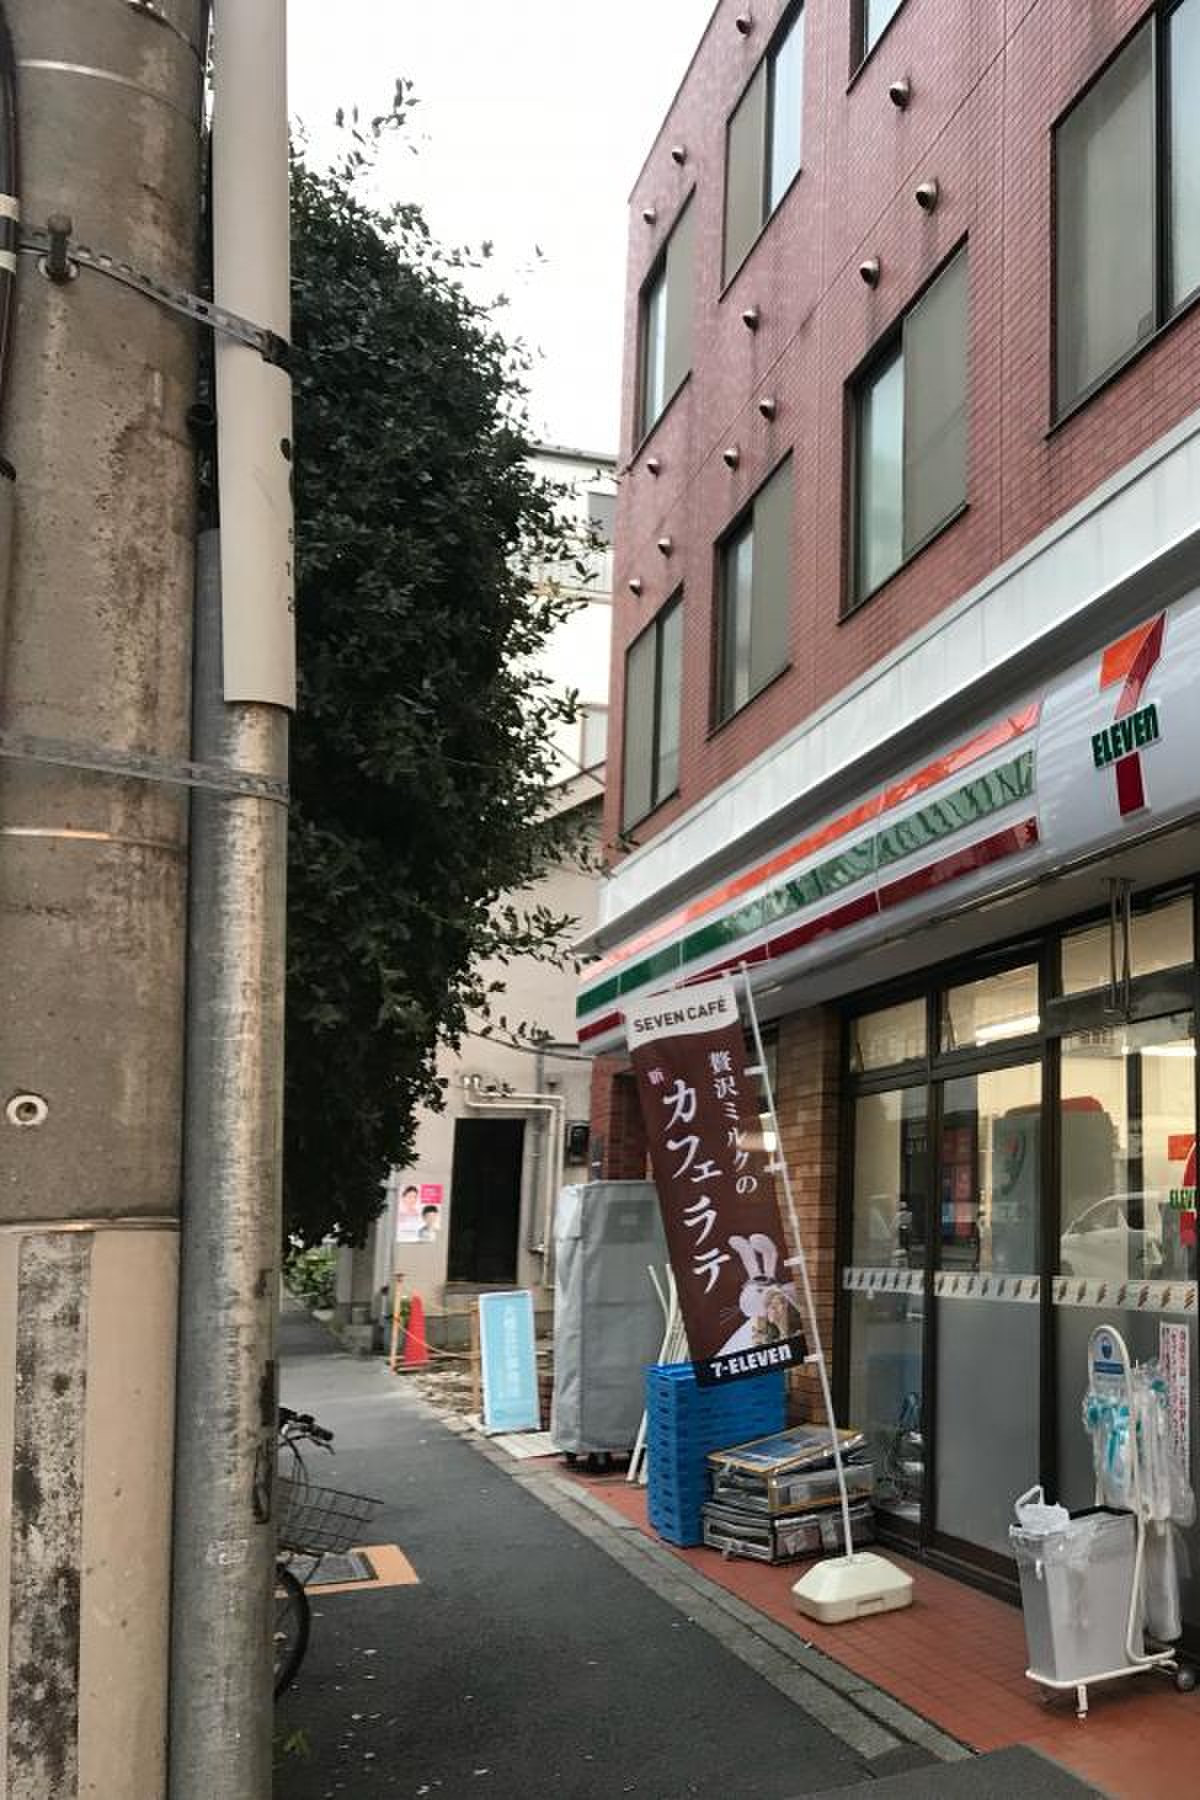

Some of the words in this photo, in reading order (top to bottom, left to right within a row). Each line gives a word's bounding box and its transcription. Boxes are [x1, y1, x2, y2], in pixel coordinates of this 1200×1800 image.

[633, 1009, 686, 1033] SEVEN
[687, 995, 728, 1020] CAFÉ
[663, 1079, 731, 1294] カフェラテ
